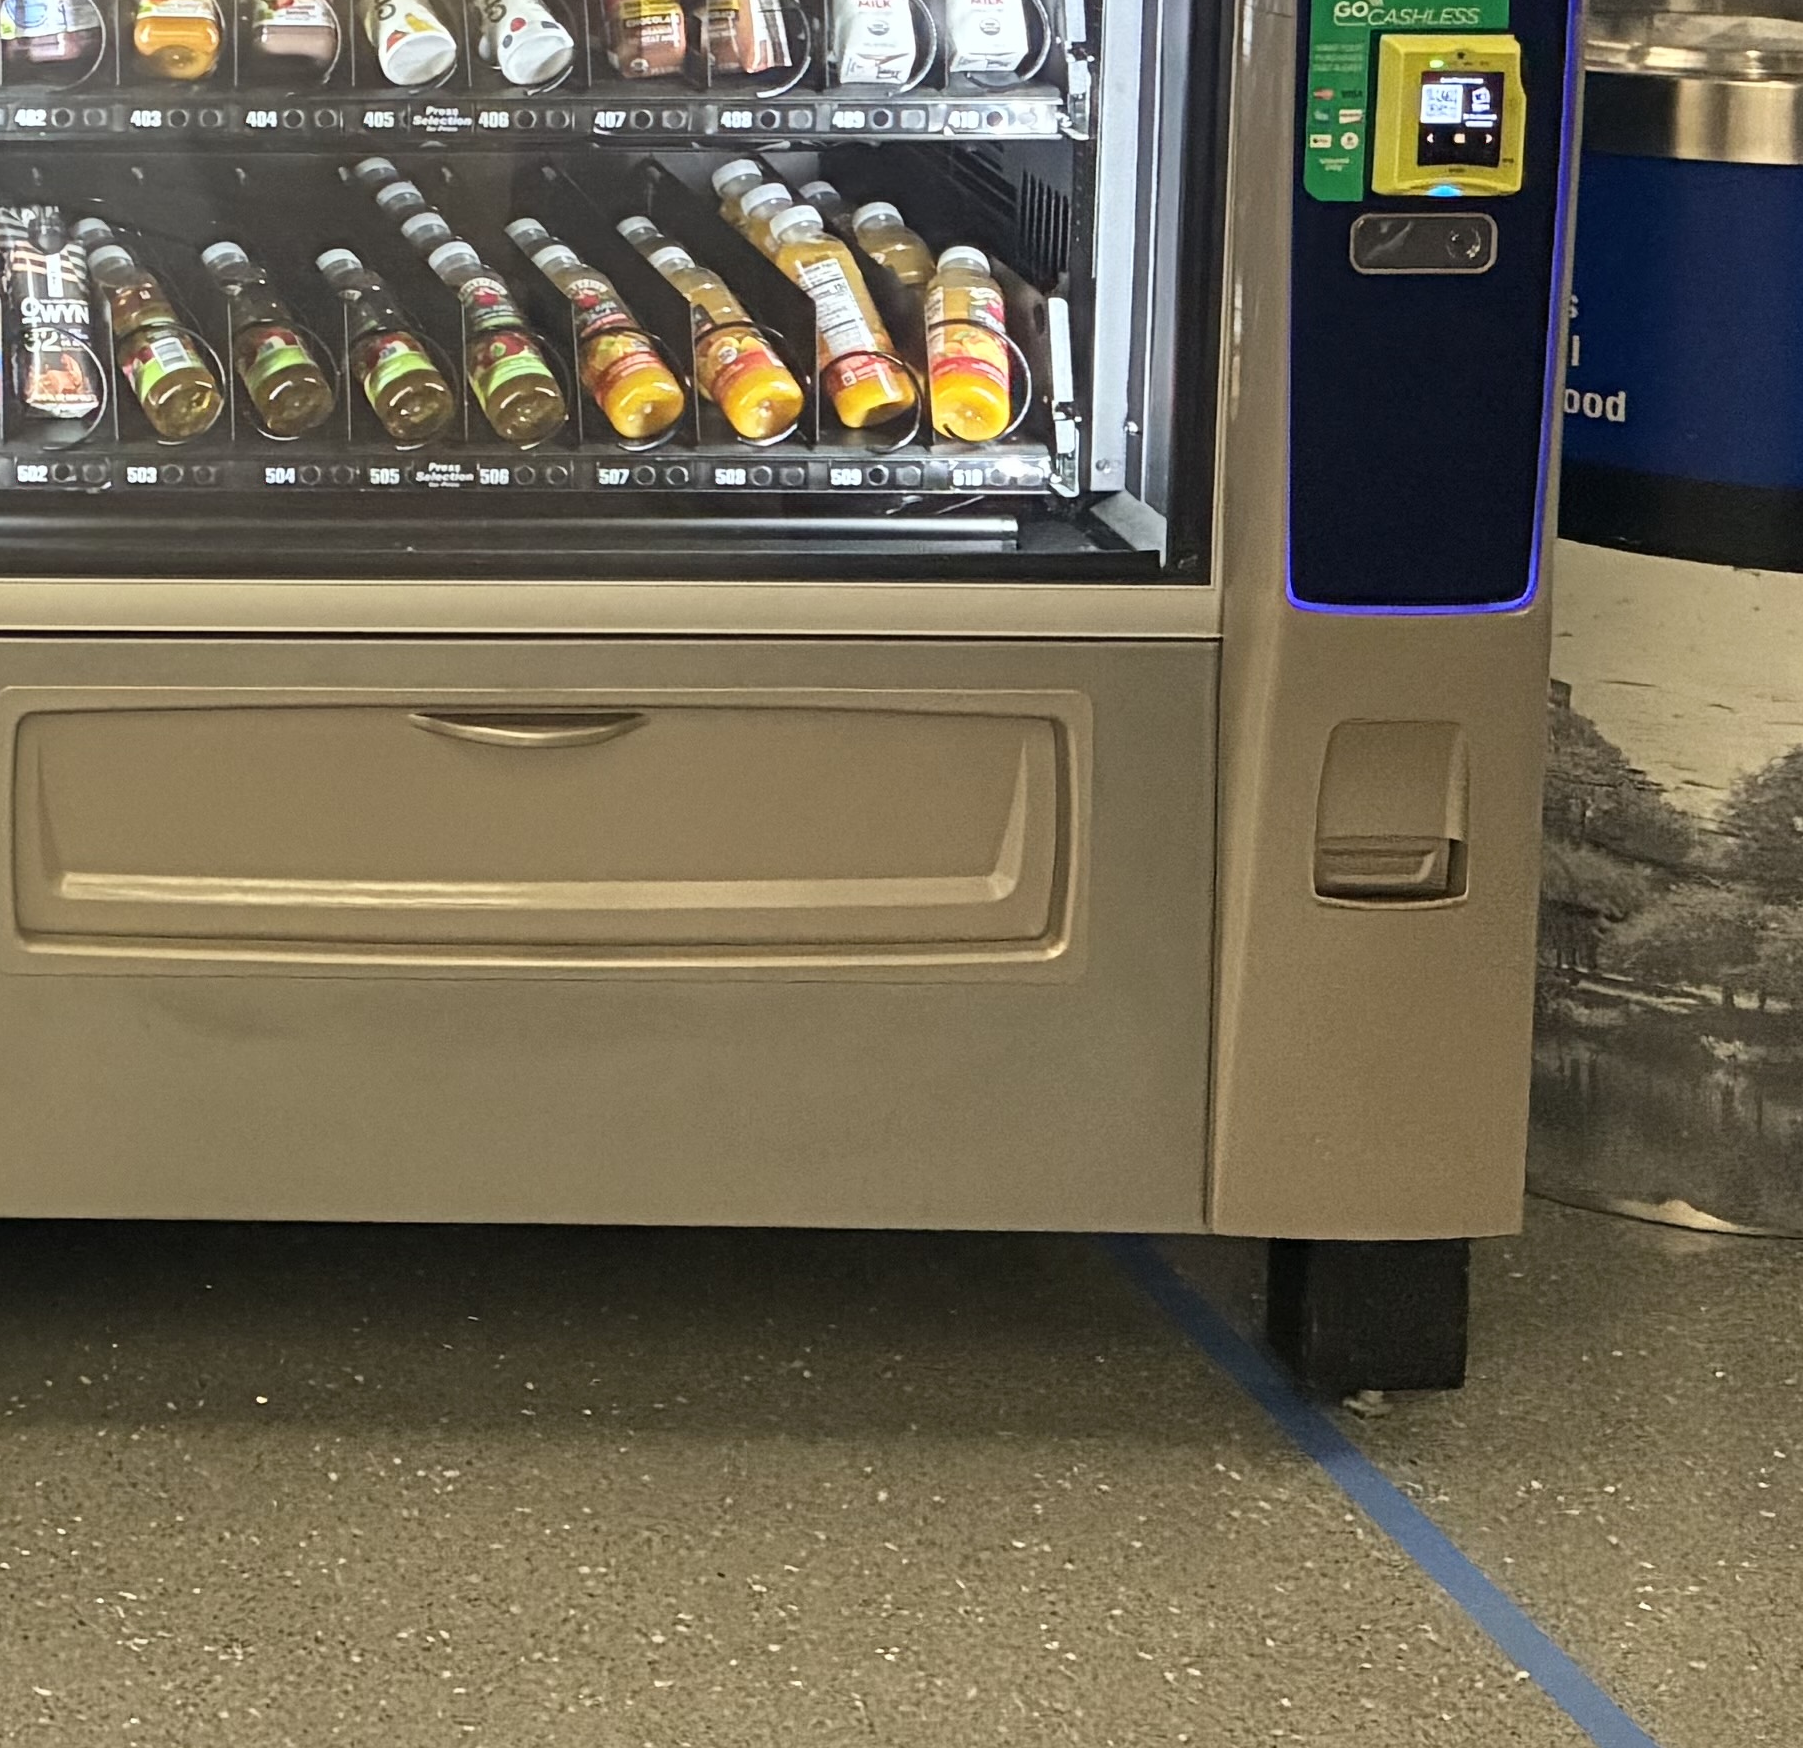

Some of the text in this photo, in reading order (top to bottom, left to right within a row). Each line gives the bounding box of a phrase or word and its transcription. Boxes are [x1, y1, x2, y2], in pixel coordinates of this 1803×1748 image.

[858, 0, 892, 8] MILK
[1334, 1, 1480, 25] GO CASHLESS
[131, 111, 161, 127] 403
[265, 466, 295, 484] 504
